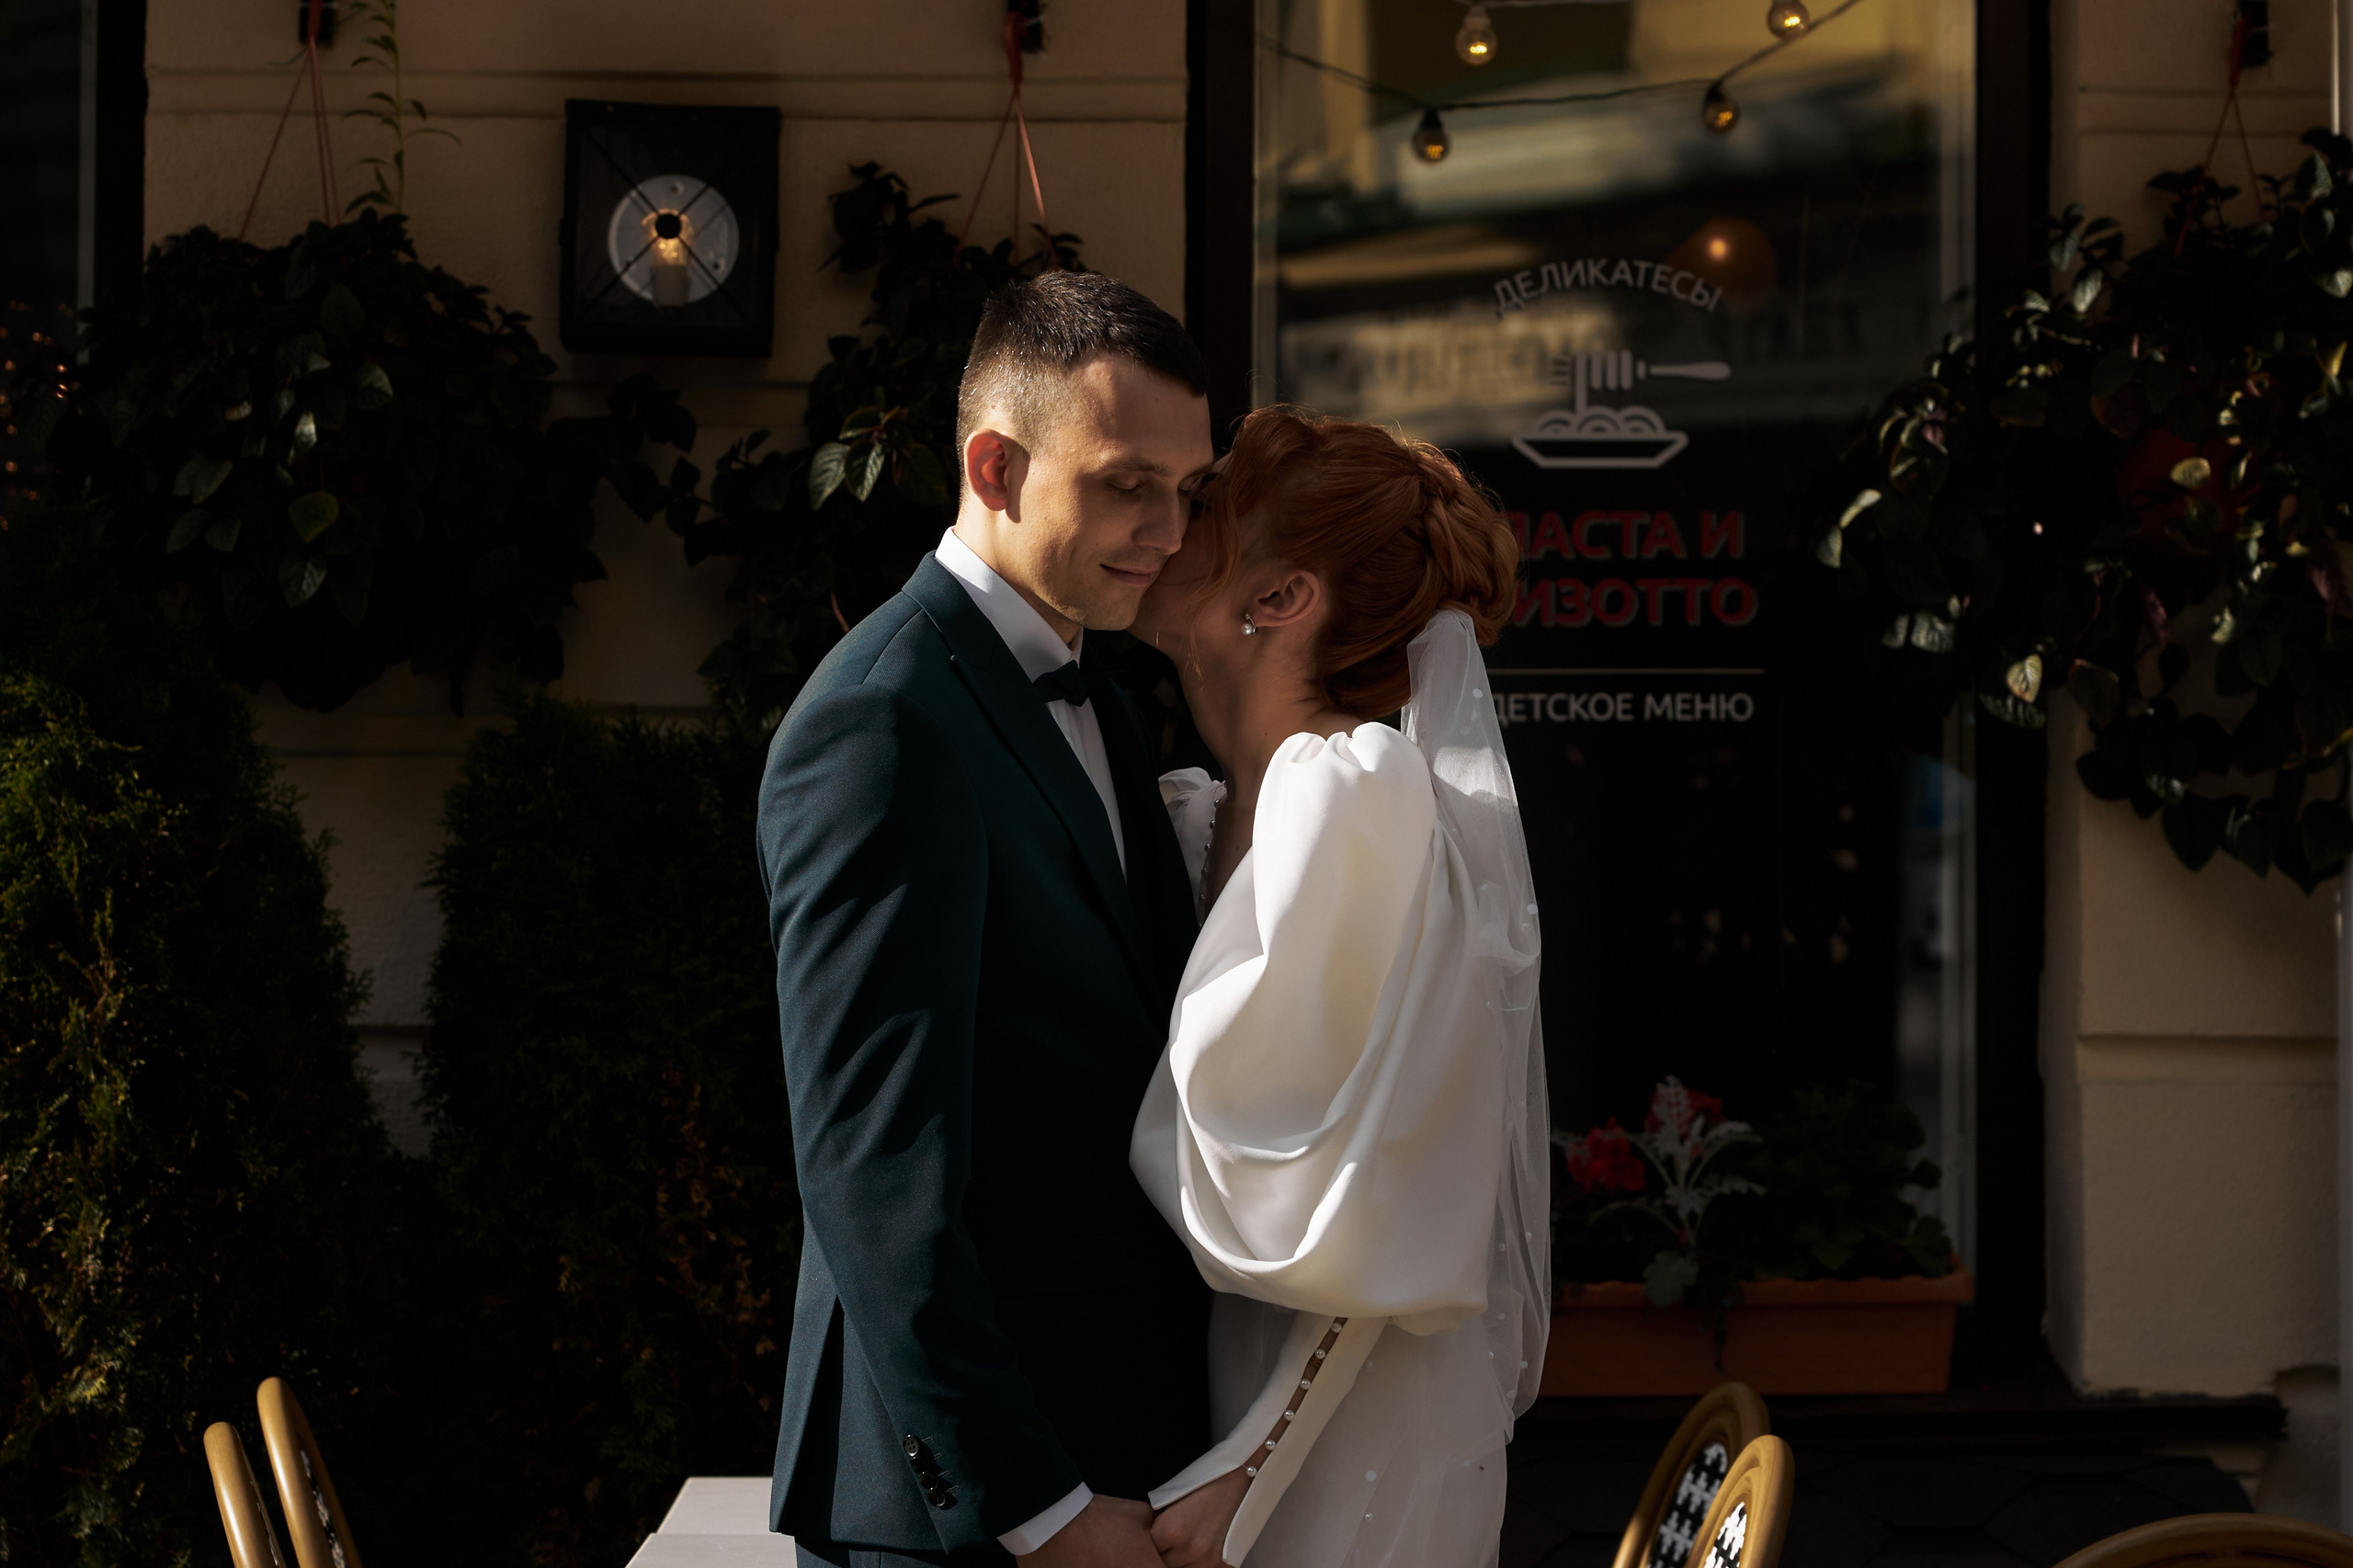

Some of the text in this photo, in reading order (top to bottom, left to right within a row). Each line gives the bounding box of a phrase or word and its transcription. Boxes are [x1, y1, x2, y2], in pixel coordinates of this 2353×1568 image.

[1493, 257, 1722, 318] ДЕЛИКАТЕСЫ
[1700, 510, 1745, 560] И
[1513, 576, 1759, 628] ИЗОТТО
[1643, 692, 1755, 722] МЕНЮ
